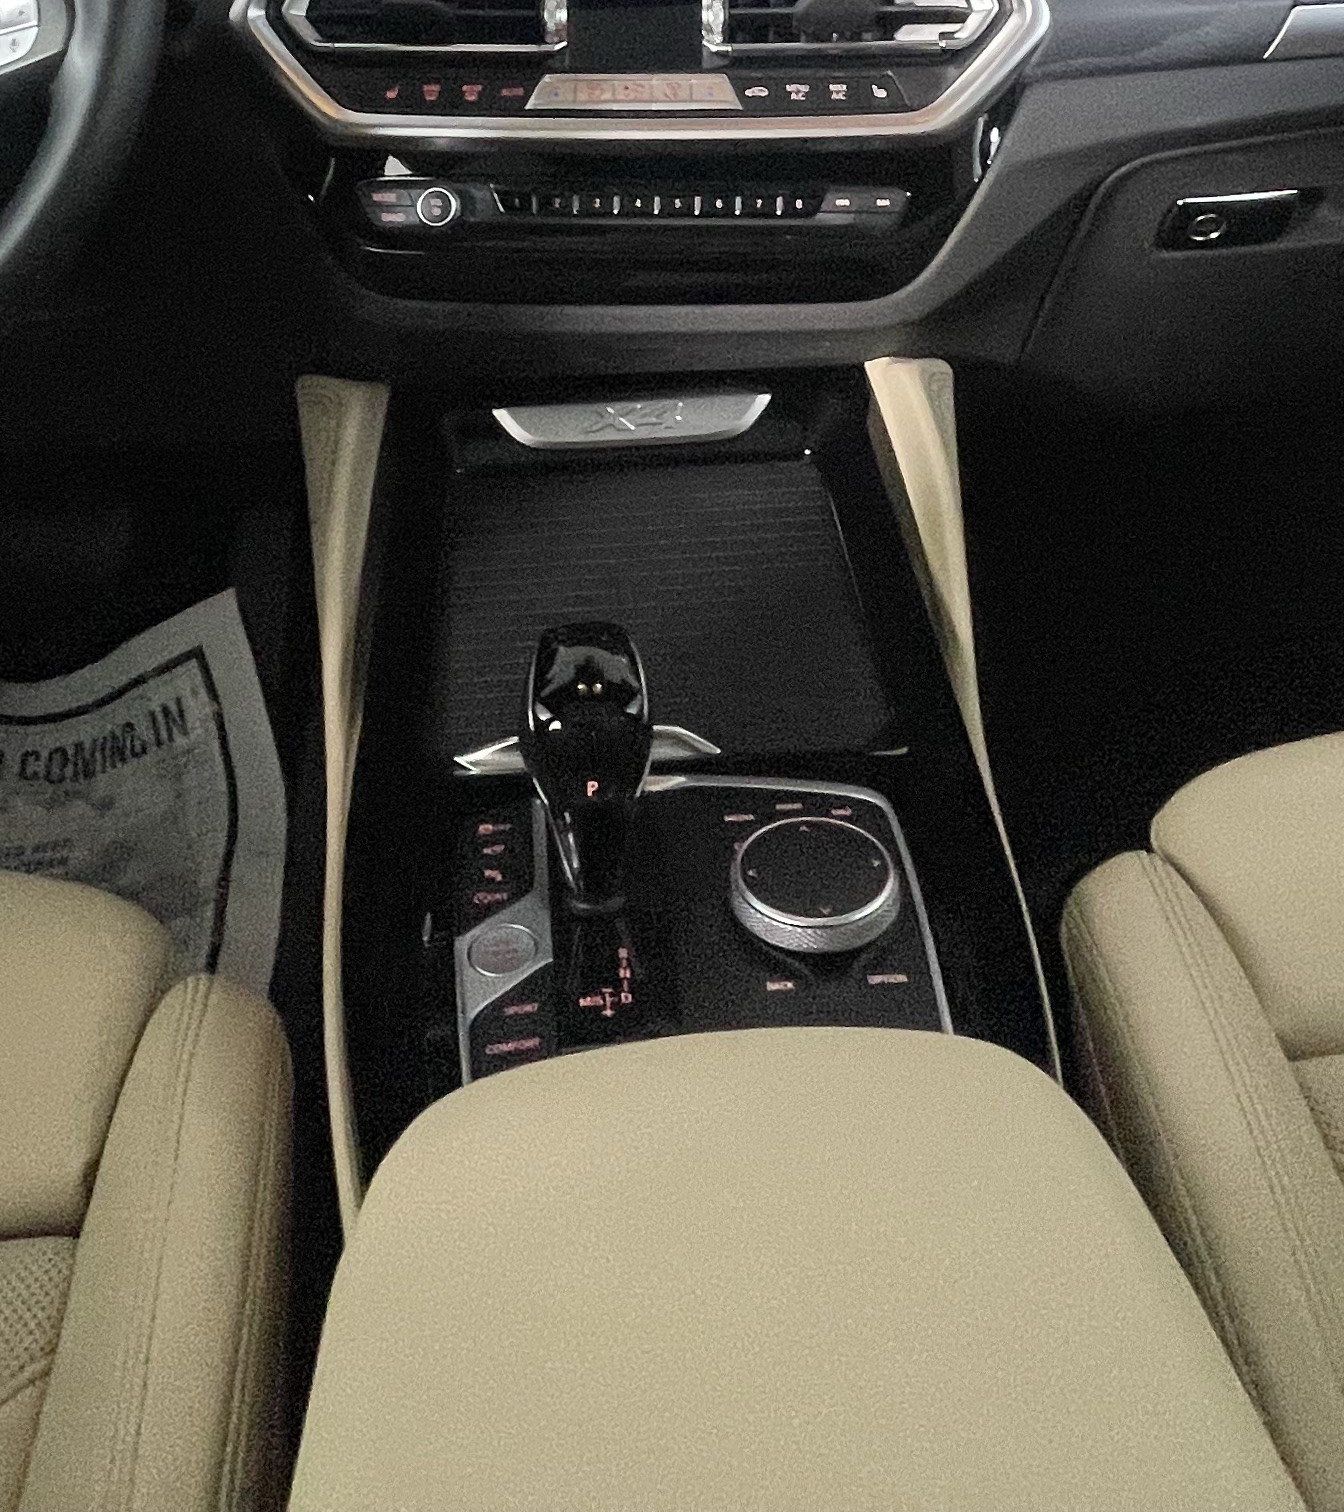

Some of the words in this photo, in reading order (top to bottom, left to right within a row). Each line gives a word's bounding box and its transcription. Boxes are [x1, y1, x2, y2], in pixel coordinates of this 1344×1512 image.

[18, 720, 149, 785] COMING
[149, 696, 191, 751] IN
[587, 781, 599, 796] P
